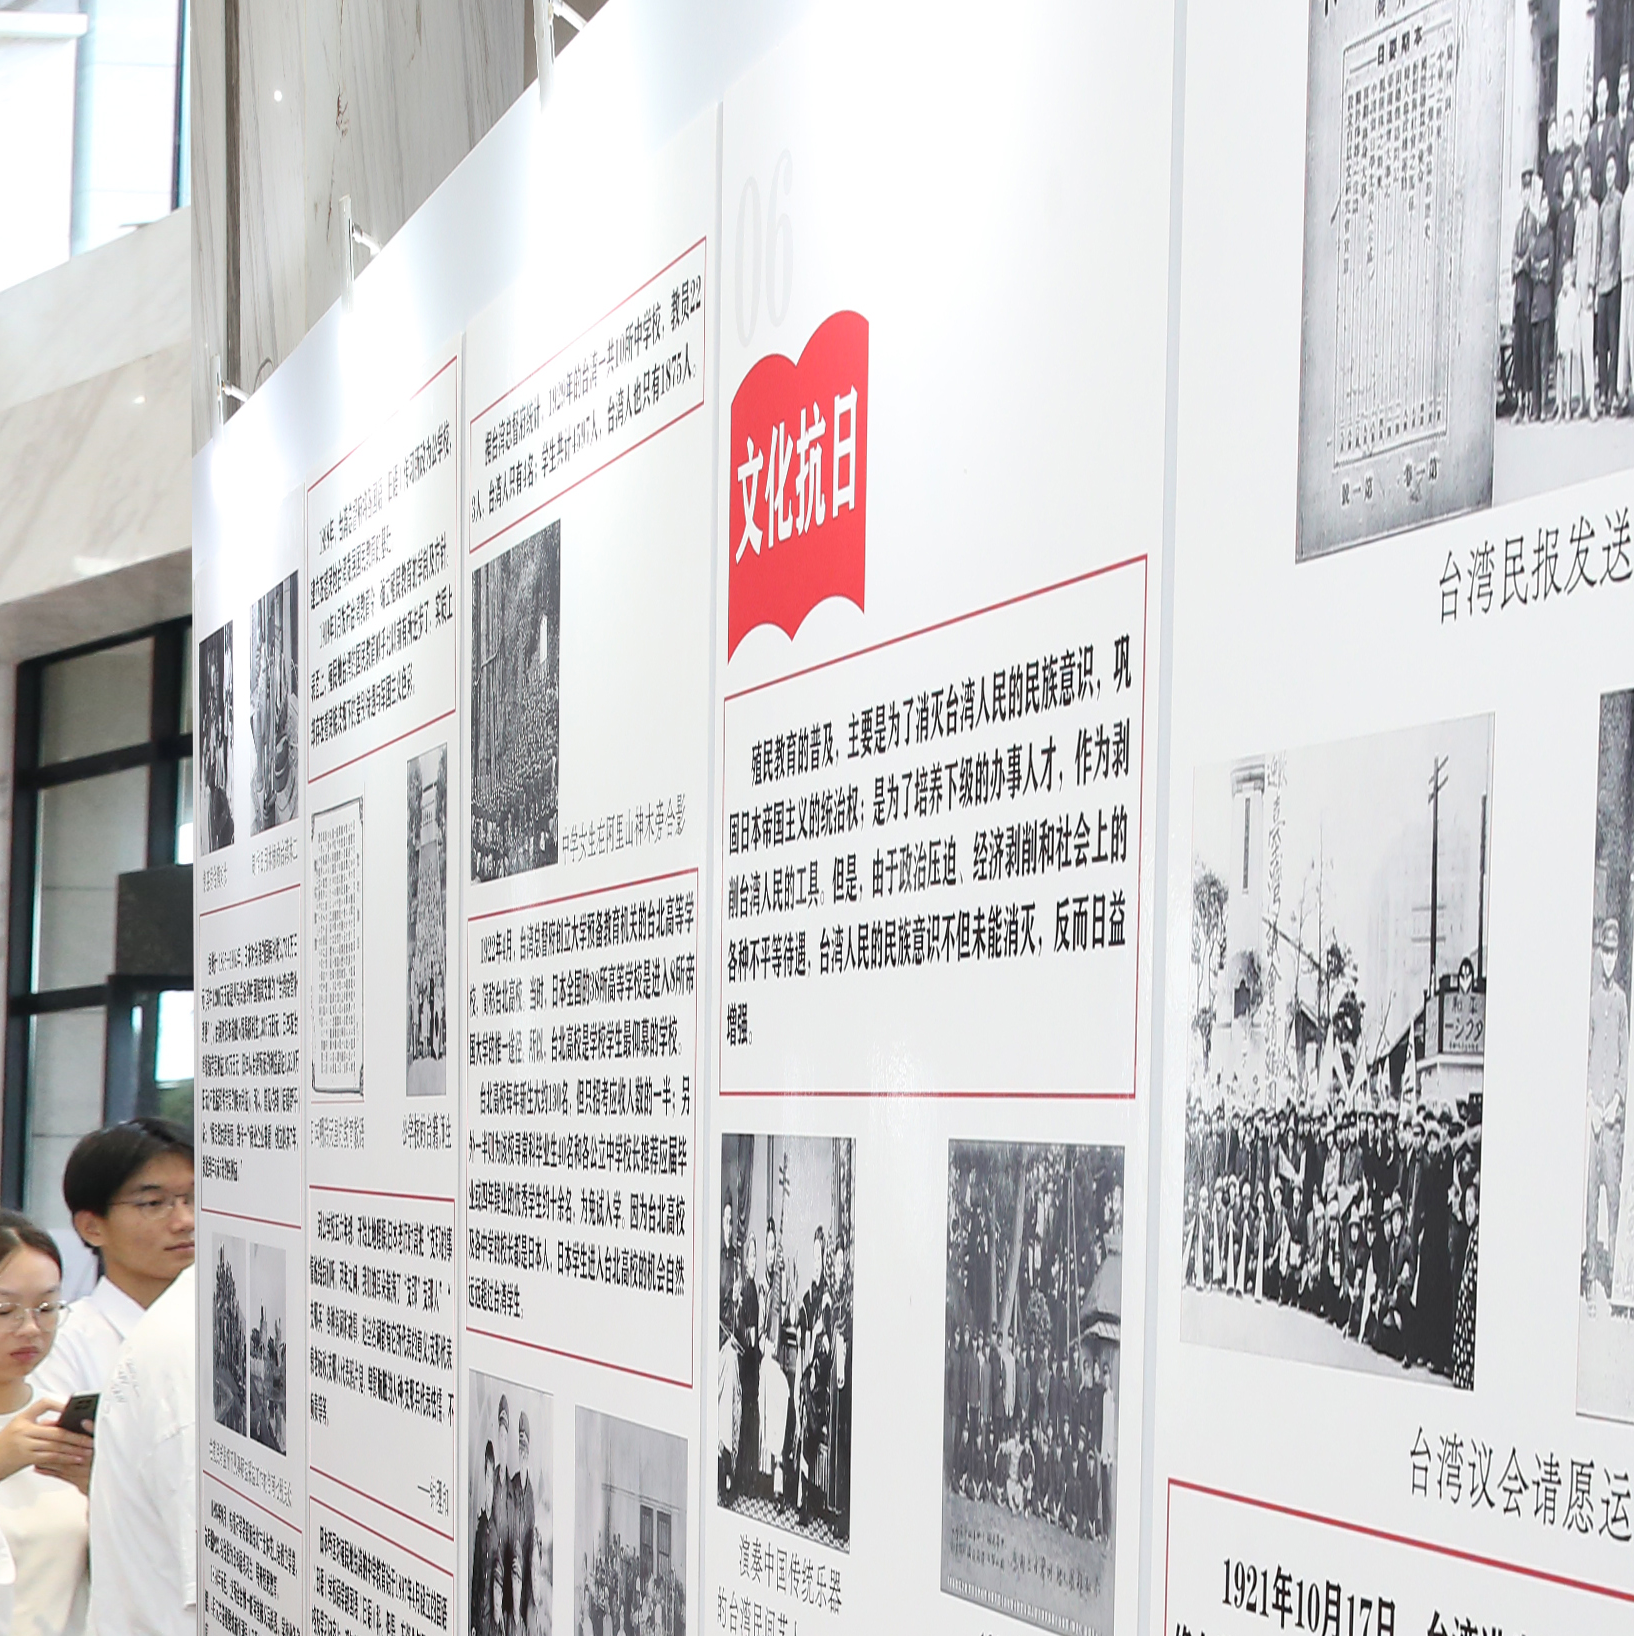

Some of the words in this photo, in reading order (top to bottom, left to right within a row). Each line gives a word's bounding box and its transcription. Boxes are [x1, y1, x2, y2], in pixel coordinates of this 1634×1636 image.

[735, 385, 858, 565] 文化抗日
[726, 1001, 752, 1047] 增强。
[738, 1533, 842, 1617] 演奏中国传统乐器
